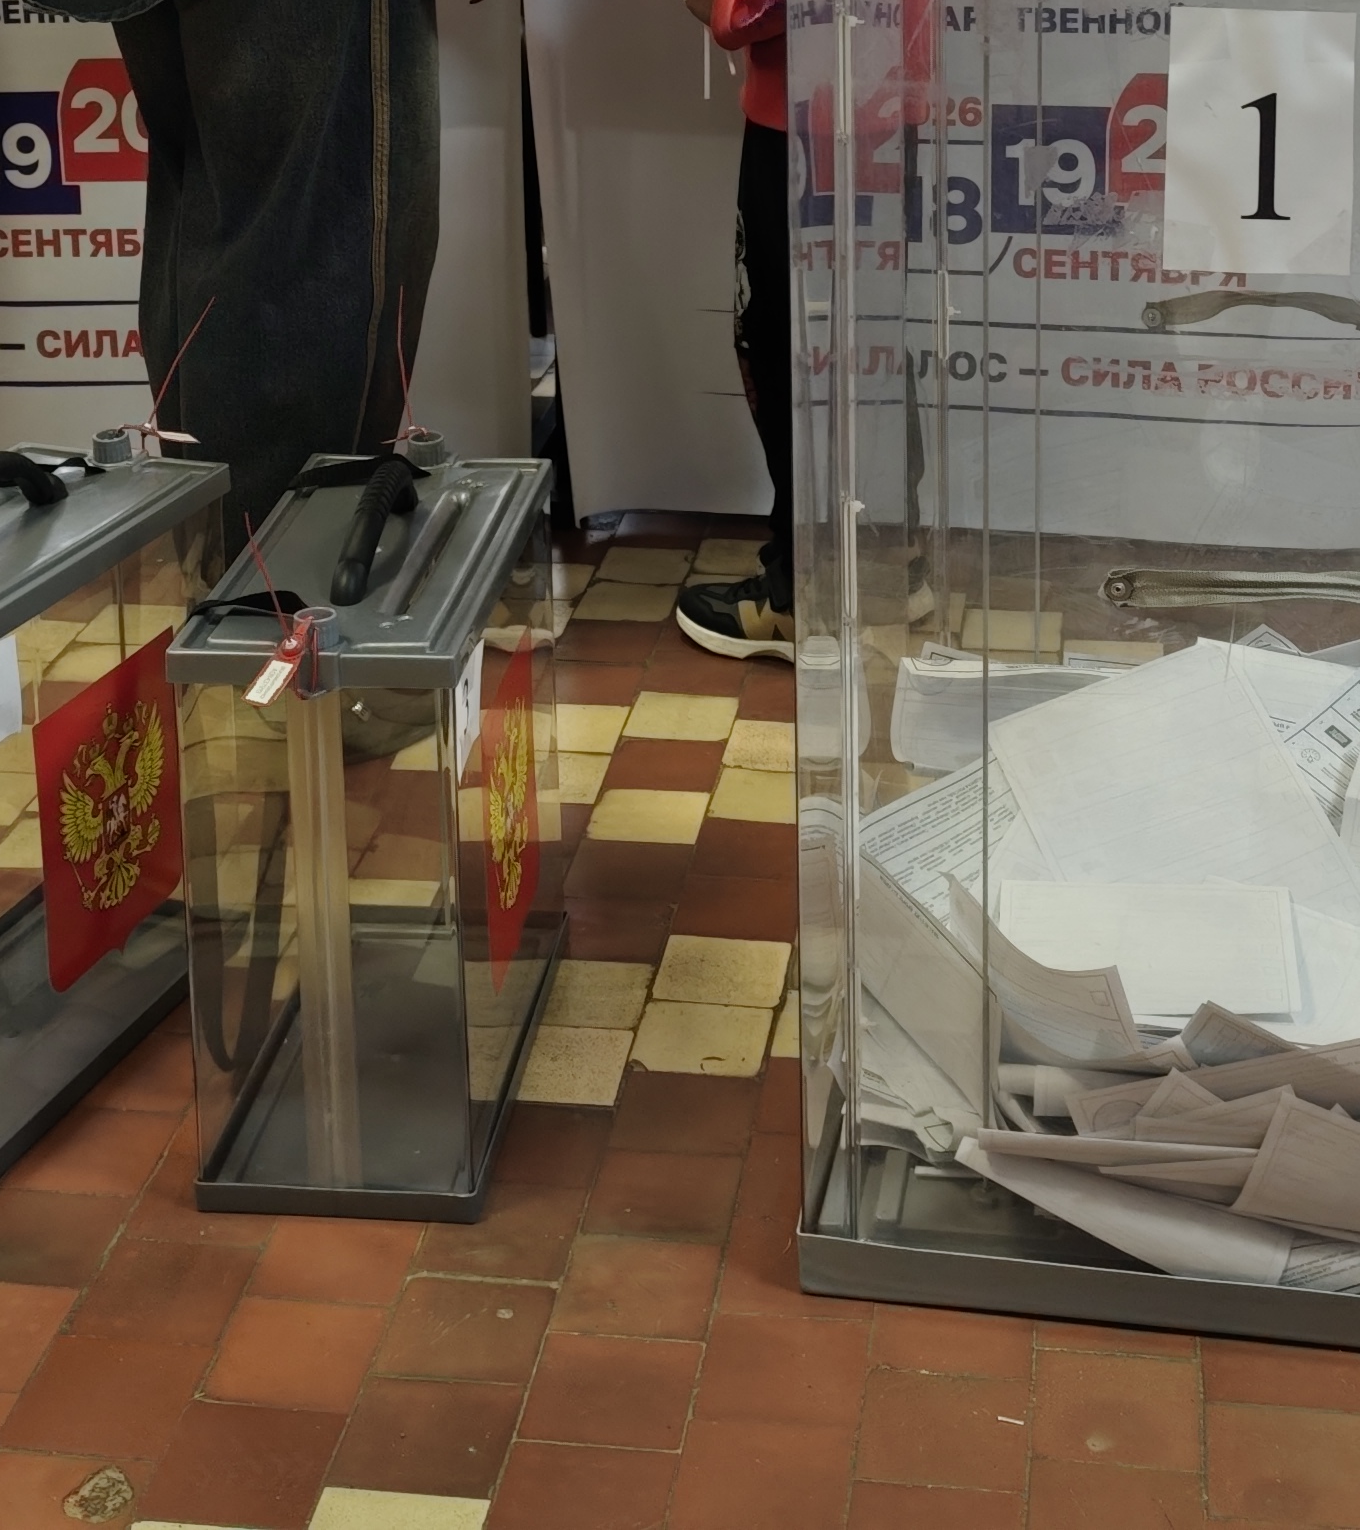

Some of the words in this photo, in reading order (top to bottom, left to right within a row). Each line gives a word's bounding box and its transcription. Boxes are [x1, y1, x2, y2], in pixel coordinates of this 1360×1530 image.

[1005, 138, 1097, 208] 19
[1121, 104, 1168, 174] 2
[1240, 92, 1292, 222] 1
[36, 329, 144, 359] СИЛА
[1061, 356, 1184, 393] СИЛА
